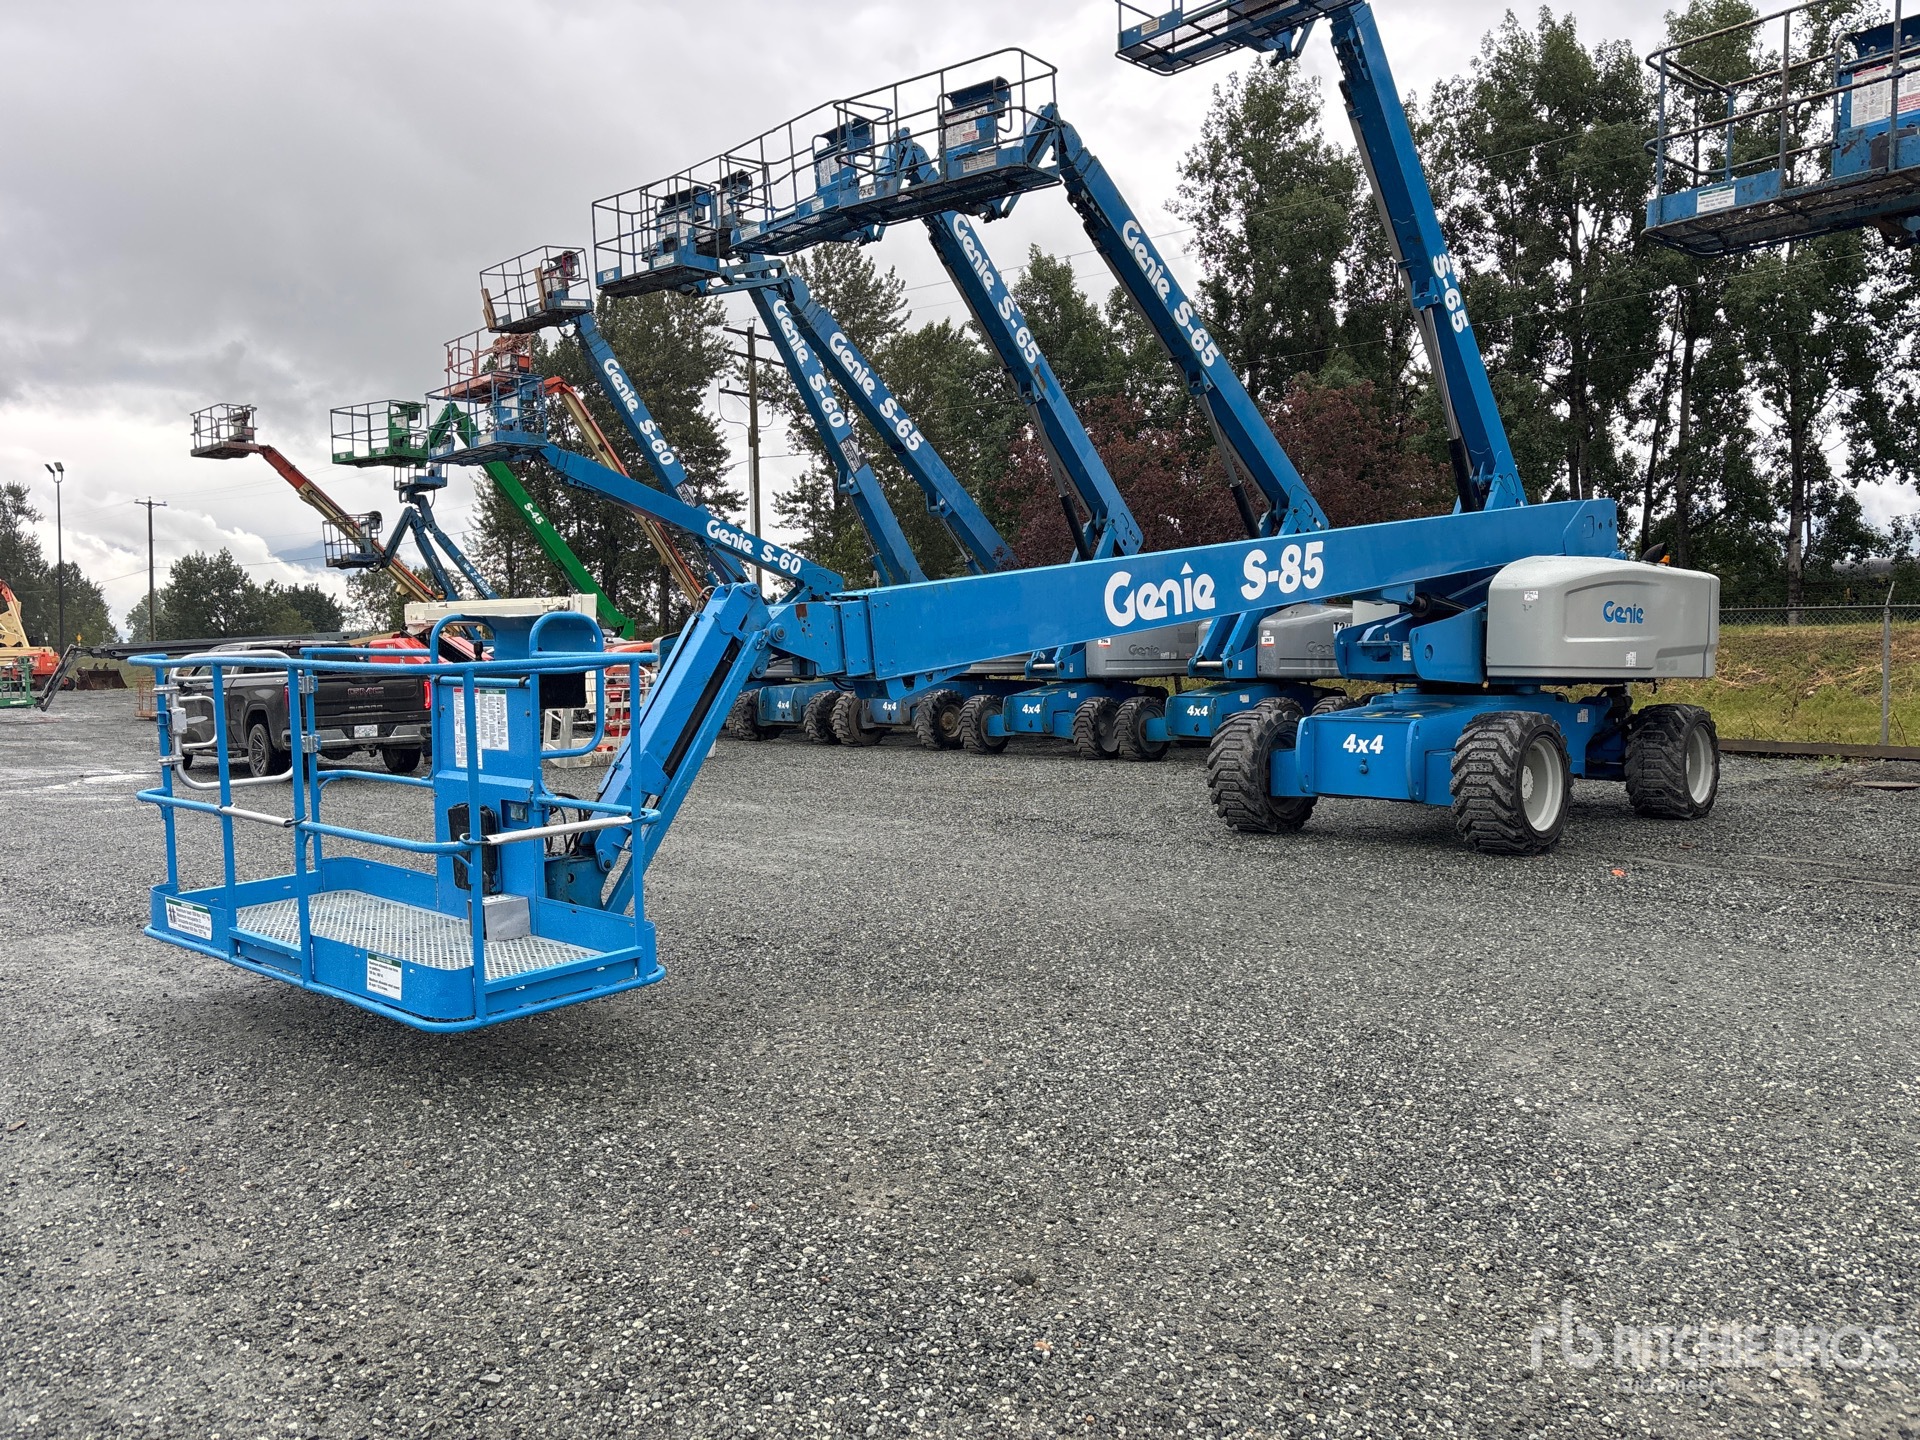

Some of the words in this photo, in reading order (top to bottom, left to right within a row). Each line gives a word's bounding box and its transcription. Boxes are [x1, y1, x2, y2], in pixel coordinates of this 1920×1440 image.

[953, 213, 994, 291] Genie
[998, 296, 1041, 364] S-65
[1123, 220, 1170, 300] Genie
[1174, 301, 1220, 367] S-65
[1433, 253, 1469, 333] S-65
[773, 300, 808, 365] Genie
[809, 373, 846, 428] S-60
[830, 332, 876, 395] Genie
[879, 397, 925, 451] S-65
[604, 358, 639, 412] Genie
[639, 419, 675, 466] S-60
[524, 502, 544, 525] S-45
[706, 520, 753, 555] Genie
[760, 544, 802, 575] S-60
[1104, 561, 1216, 627] Genie
[1240, 540, 1324, 601] S-85
[1602, 600, 1644, 624] Genie
[1128, 644, 1160, 656] Genie
[1306, 641, 1335, 656] Gen
[347, 686, 384, 696] GMC
[777, 700, 790, 709] 4x4
[882, 701, 898, 711] 4x4
[1021, 703, 1041, 714] 4x4
[1186, 705, 1209, 717] 4x4
[1342, 733, 1384, 755] 4x4
